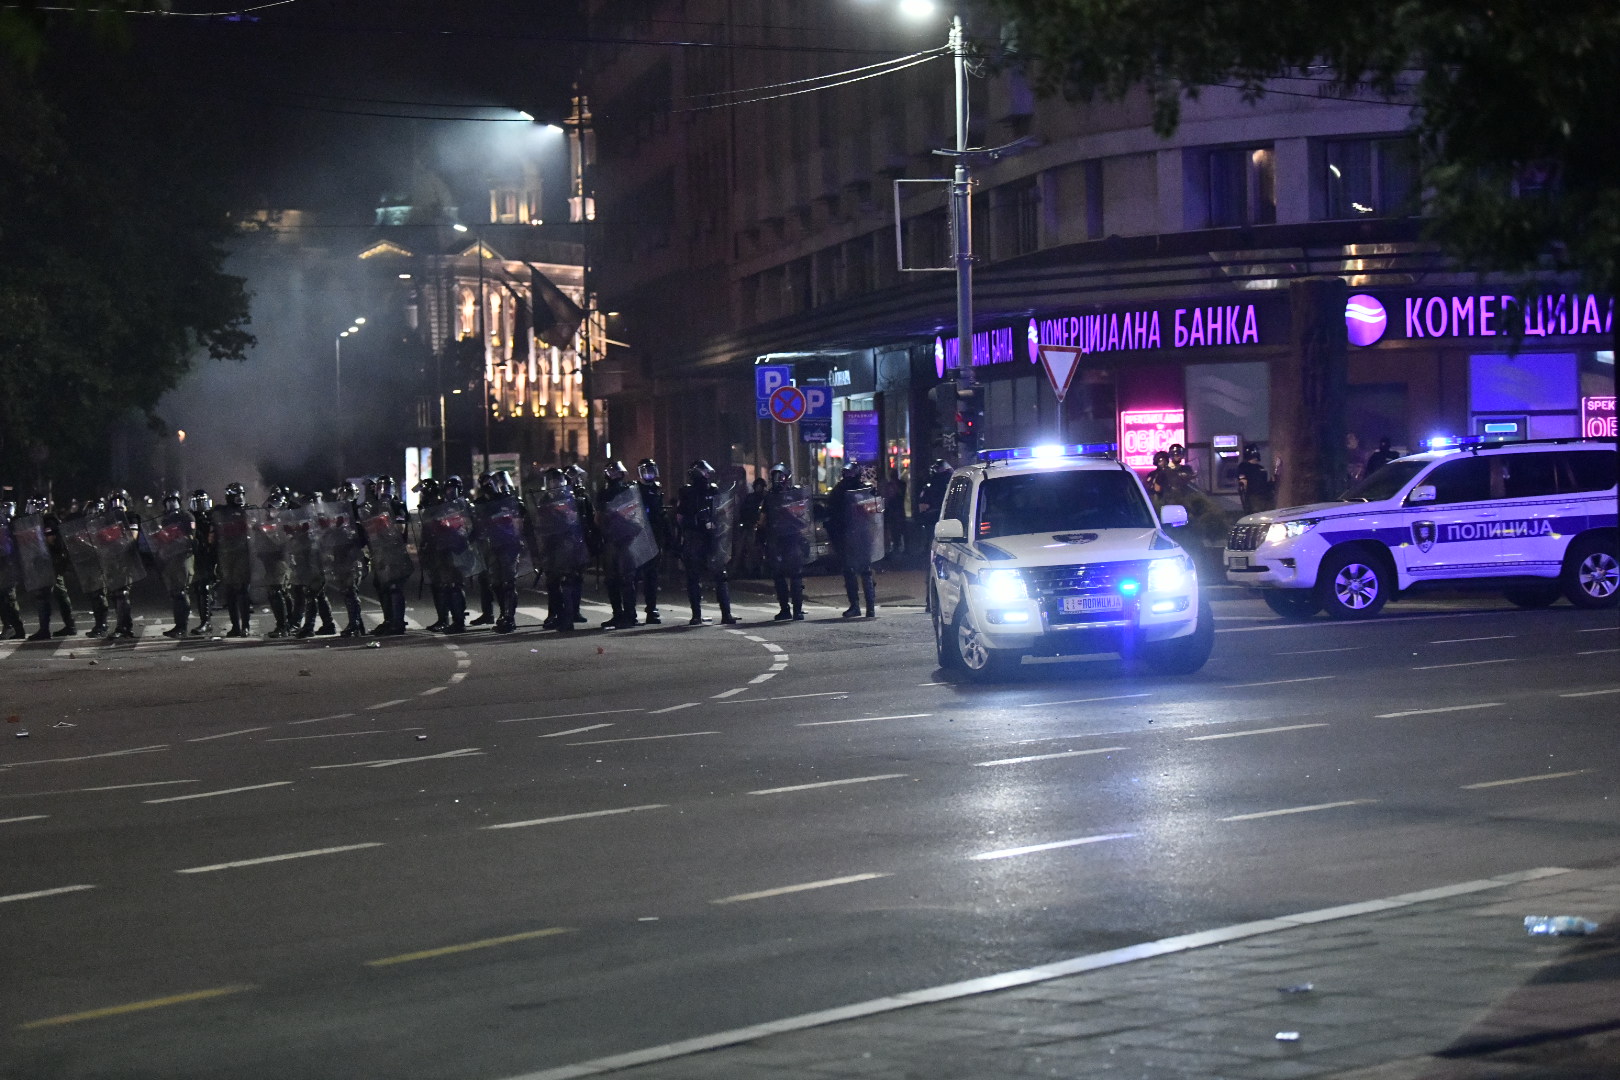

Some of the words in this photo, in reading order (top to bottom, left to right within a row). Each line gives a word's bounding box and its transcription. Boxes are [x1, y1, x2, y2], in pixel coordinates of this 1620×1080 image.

[1174, 304, 1259, 348] БАНКА
[991, 326, 1014, 364] БАНКА
[764, 371, 782, 394] P
[806, 389, 825, 414] P
[1448, 520, 1554, 540] ПОЛИЦИЈА
[1082, 597, 1121, 609] ПОЛИЦИЈА
